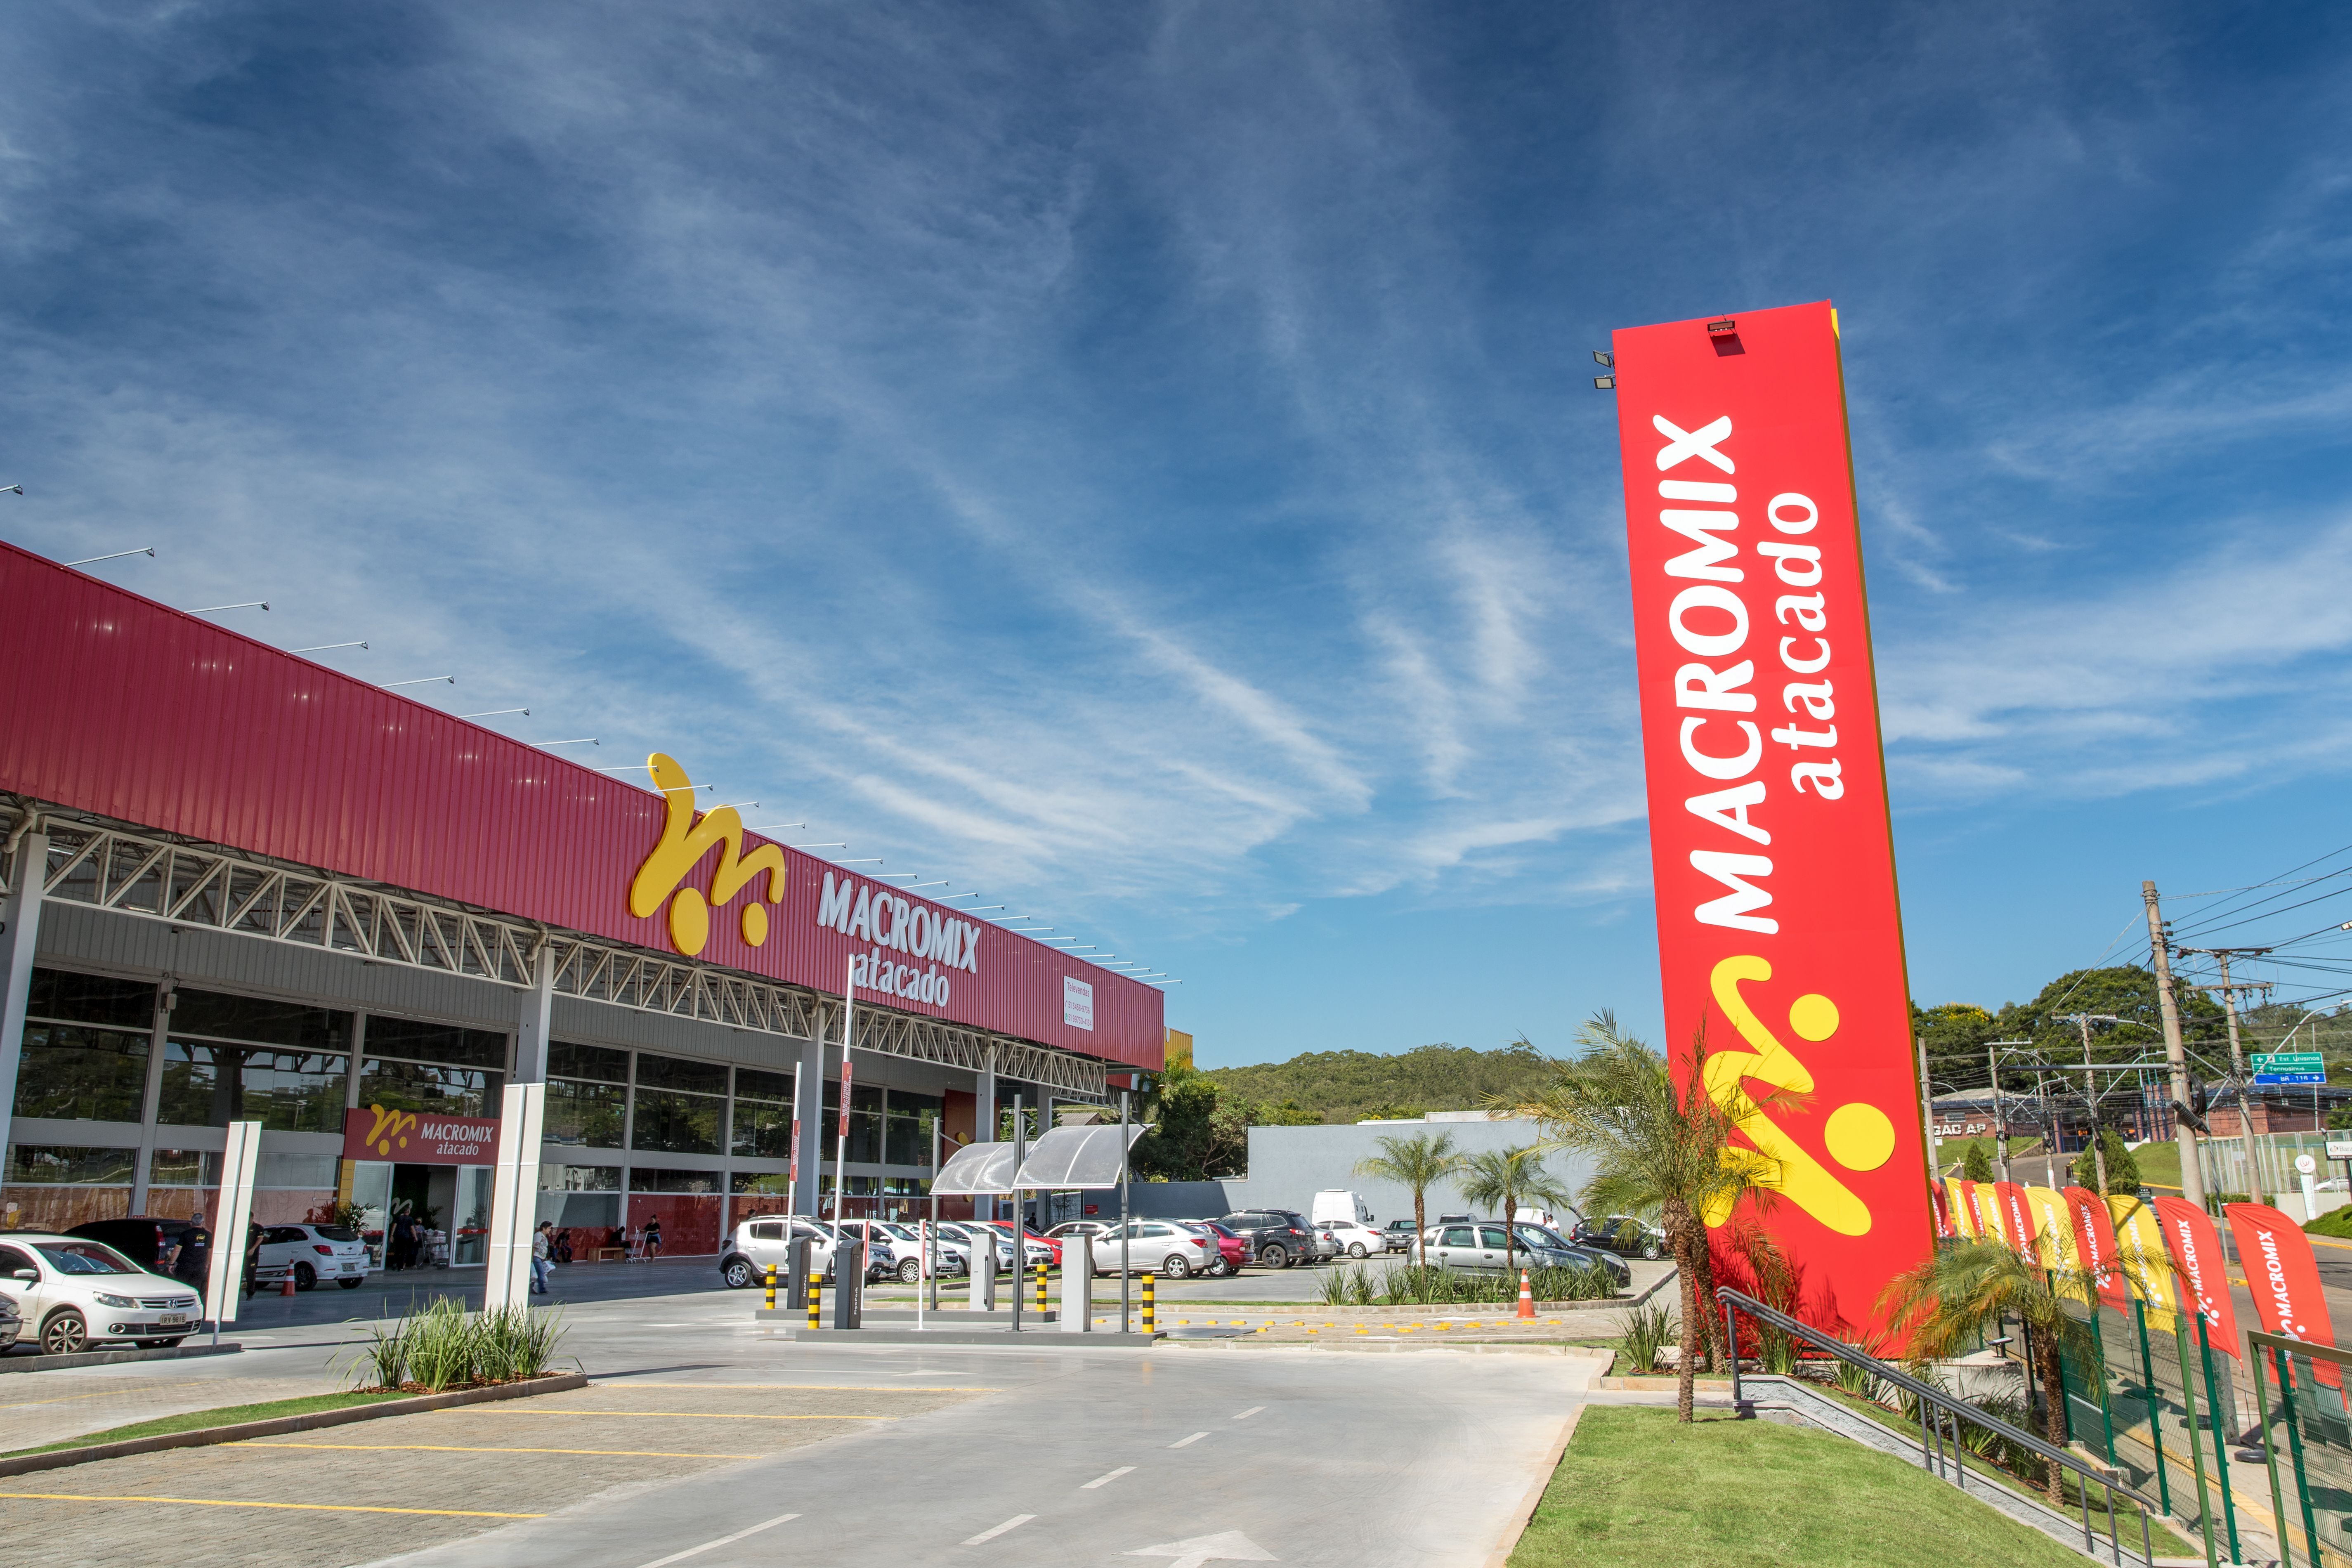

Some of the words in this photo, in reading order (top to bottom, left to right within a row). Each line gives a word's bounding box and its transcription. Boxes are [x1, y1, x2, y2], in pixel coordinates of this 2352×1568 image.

[1756, 492, 1844, 801] atacado
[1652, 414, 1779, 935] MACROMIX
[817, 871, 981, 974] MACROMIX
[853, 947, 949, 1008] atacado
[1067, 982, 1090, 997] Televendas
[420, 1122, 494, 1143] MACROMIX
[436, 1141, 479, 1155] atacado
[1954, 1189, 1964, 1226] MACROMIX
[1971, 1193, 1984, 1231] MACROMIX
[2009, 1196, 2027, 1241] MACROMIX
[2177, 1219, 2203, 1291] MACROMIX
[2256, 1230, 2293, 1317] MACROMIX
